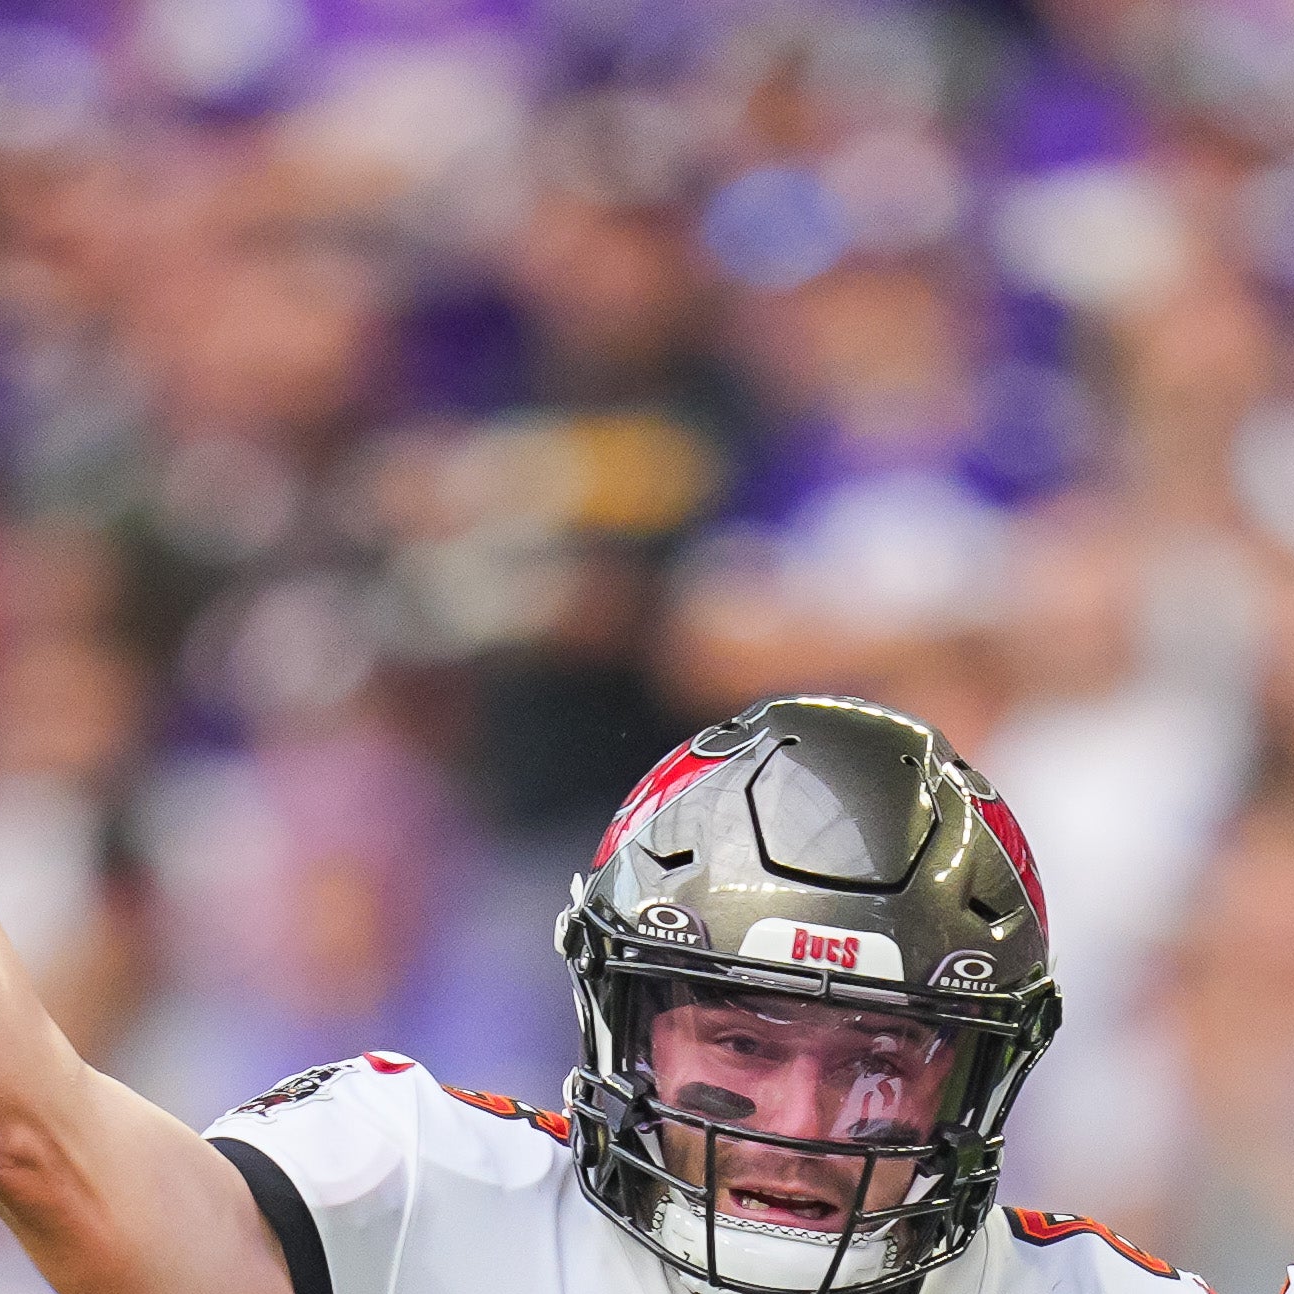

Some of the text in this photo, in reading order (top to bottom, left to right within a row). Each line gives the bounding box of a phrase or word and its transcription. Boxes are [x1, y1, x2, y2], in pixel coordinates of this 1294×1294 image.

[637, 924, 701, 945] OAKLEY
[792, 927, 860, 969] BUCS
[940, 976, 999, 992] OAKLEY
